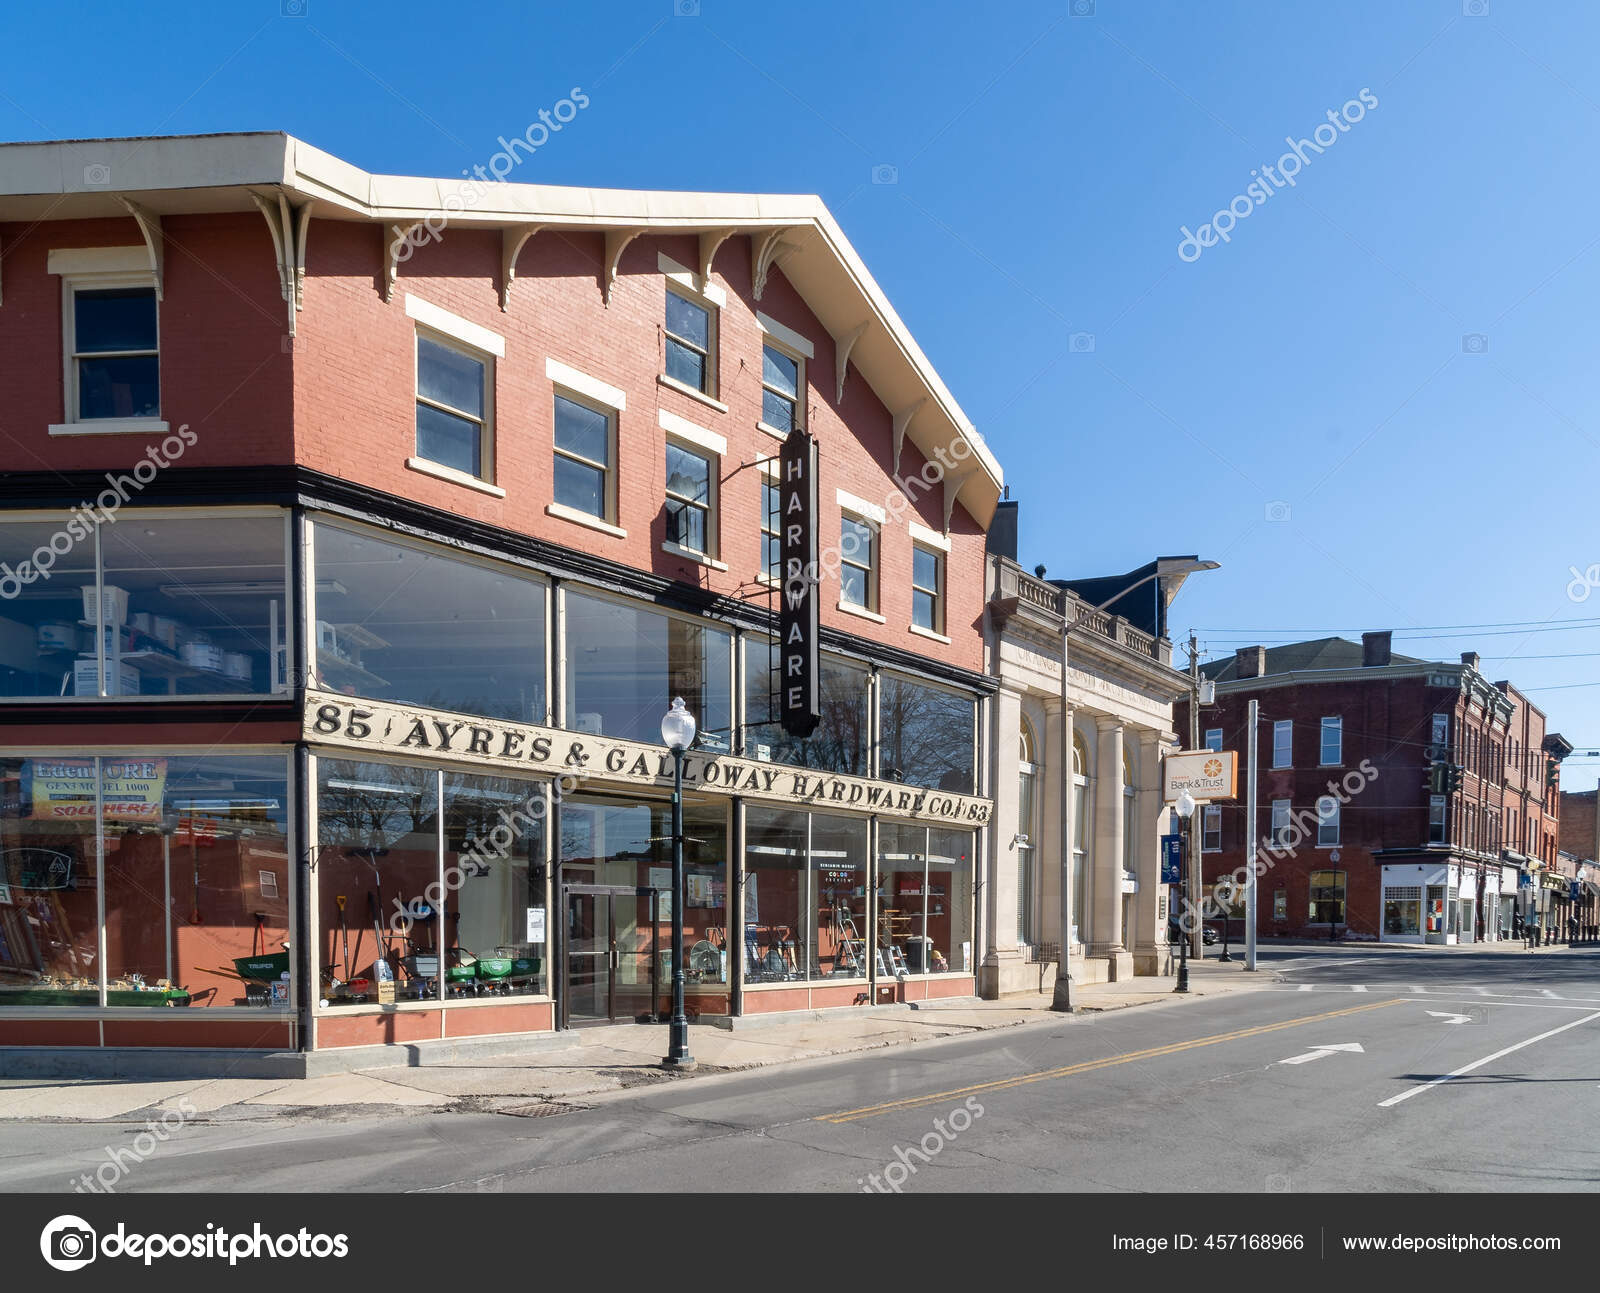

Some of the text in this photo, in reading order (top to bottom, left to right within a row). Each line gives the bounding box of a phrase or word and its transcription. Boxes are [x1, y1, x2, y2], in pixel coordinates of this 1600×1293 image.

[786, 458, 803, 709] HARDWARE
[37, 762, 158, 780] EdenURE
[126, 783, 150, 792] 1000
[313, 704, 373, 739] 85
[396, 716, 553, 762] AYRES
[565, 741, 590, 768] &
[606, 749, 780, 792] GALLOWAY
[792, 773, 926, 812] HARDWARE
[967, 803, 988, 822] 83
